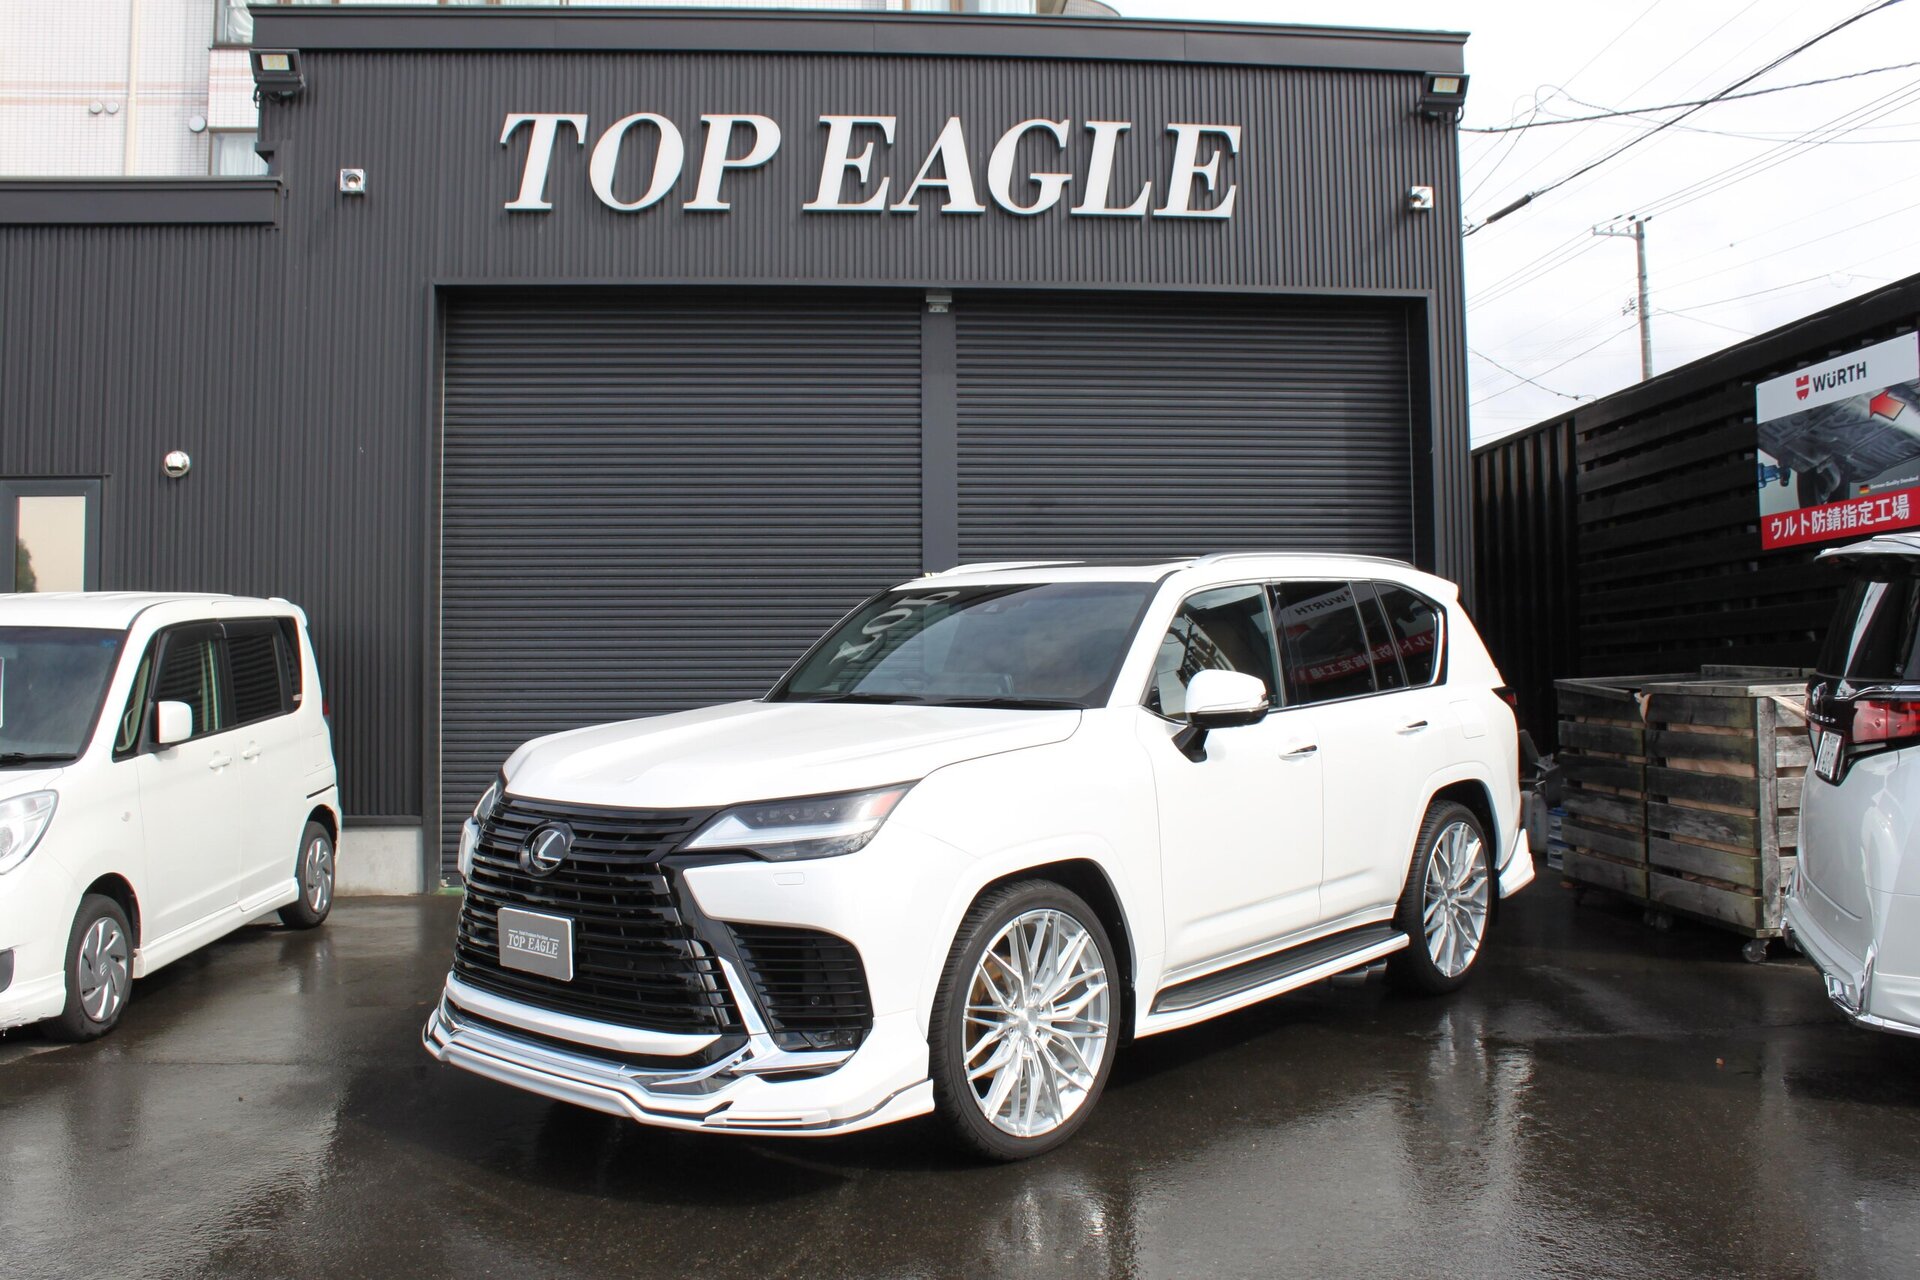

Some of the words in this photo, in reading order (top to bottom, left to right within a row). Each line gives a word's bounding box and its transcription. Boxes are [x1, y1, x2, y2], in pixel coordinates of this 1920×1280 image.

[500, 113, 782, 212] TOP
[802, 115, 1242, 218] EAGLE
[1771, 493, 1910, 540] ウルト防錆指定工場
[508, 933, 526, 948] TOP
[528, 937, 559, 956] EAGLE
